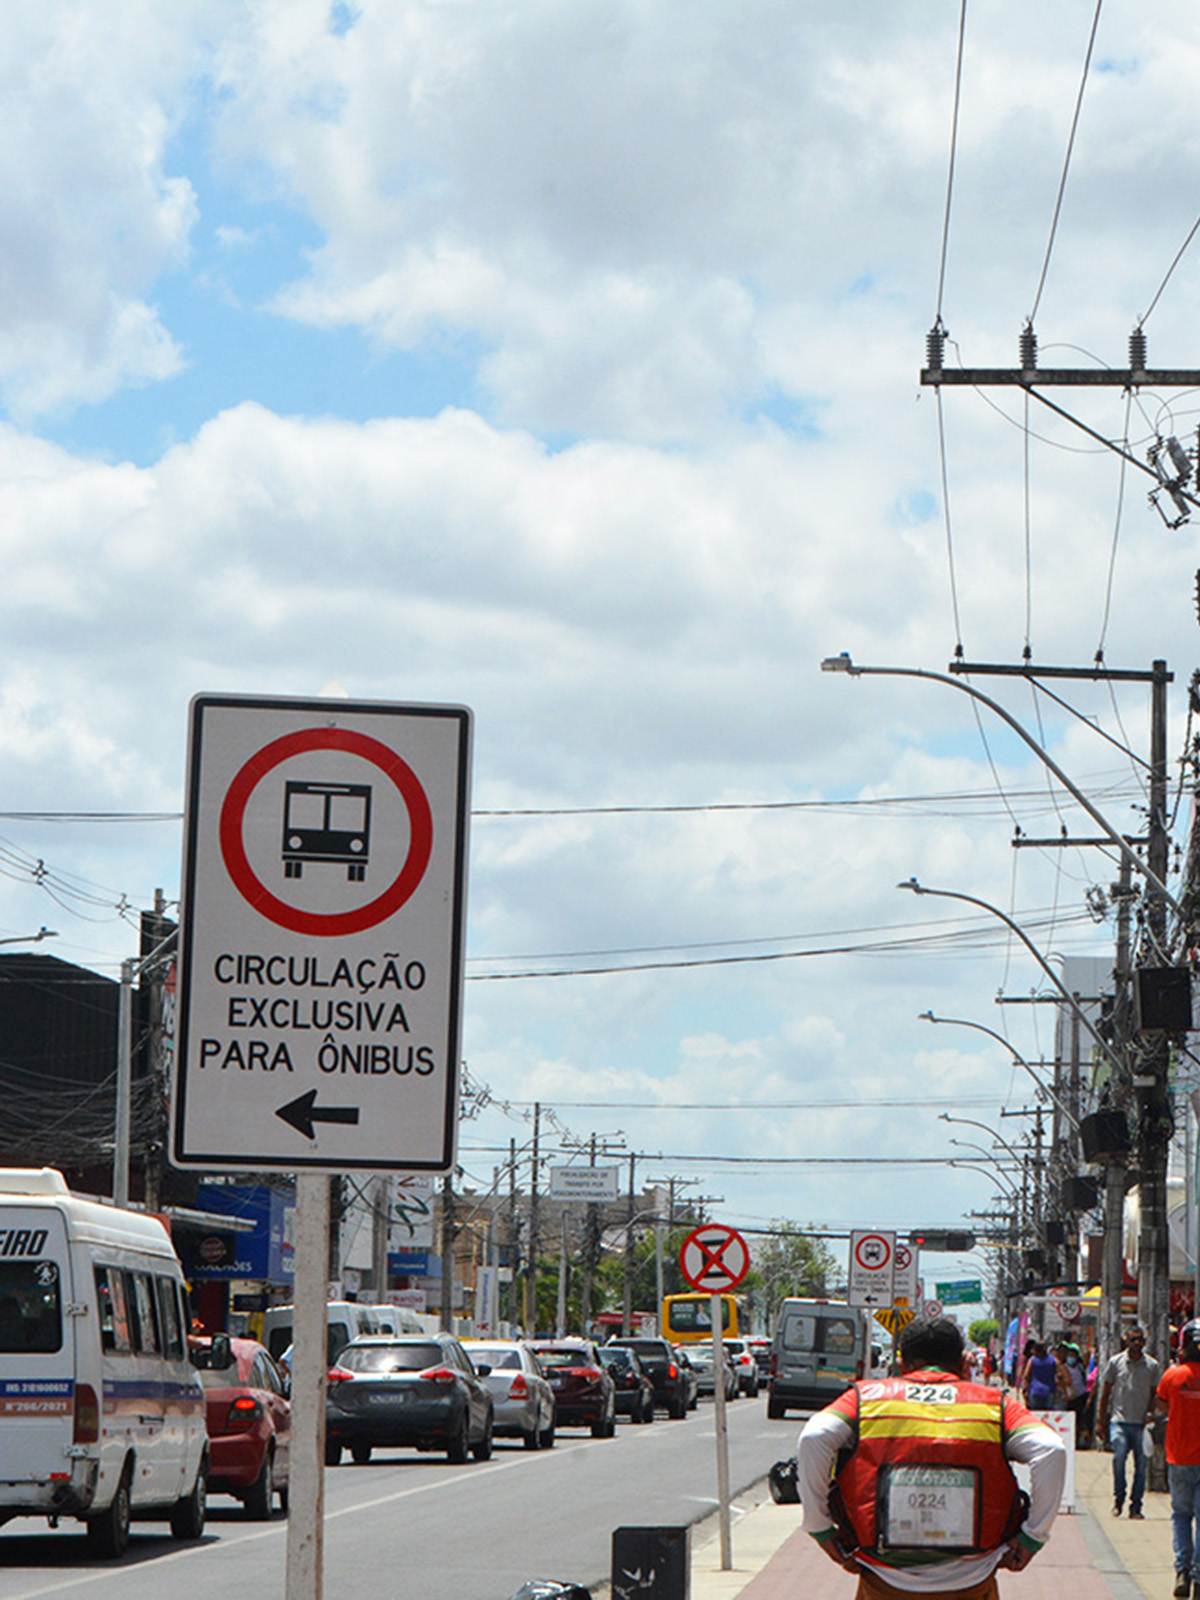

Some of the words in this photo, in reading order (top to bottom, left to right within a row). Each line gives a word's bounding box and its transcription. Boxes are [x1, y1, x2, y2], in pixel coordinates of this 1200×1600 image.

[214, 952, 426, 995] CIRCULAÇÃO
[228, 997, 411, 1033] EXCLUSIVA
[199, 1038, 294, 1072] PARA
[317, 1032, 436, 1076] ÔNIBUS
[906, 1385, 954, 1401] 224
[908, 1493, 948, 1508] 0224
